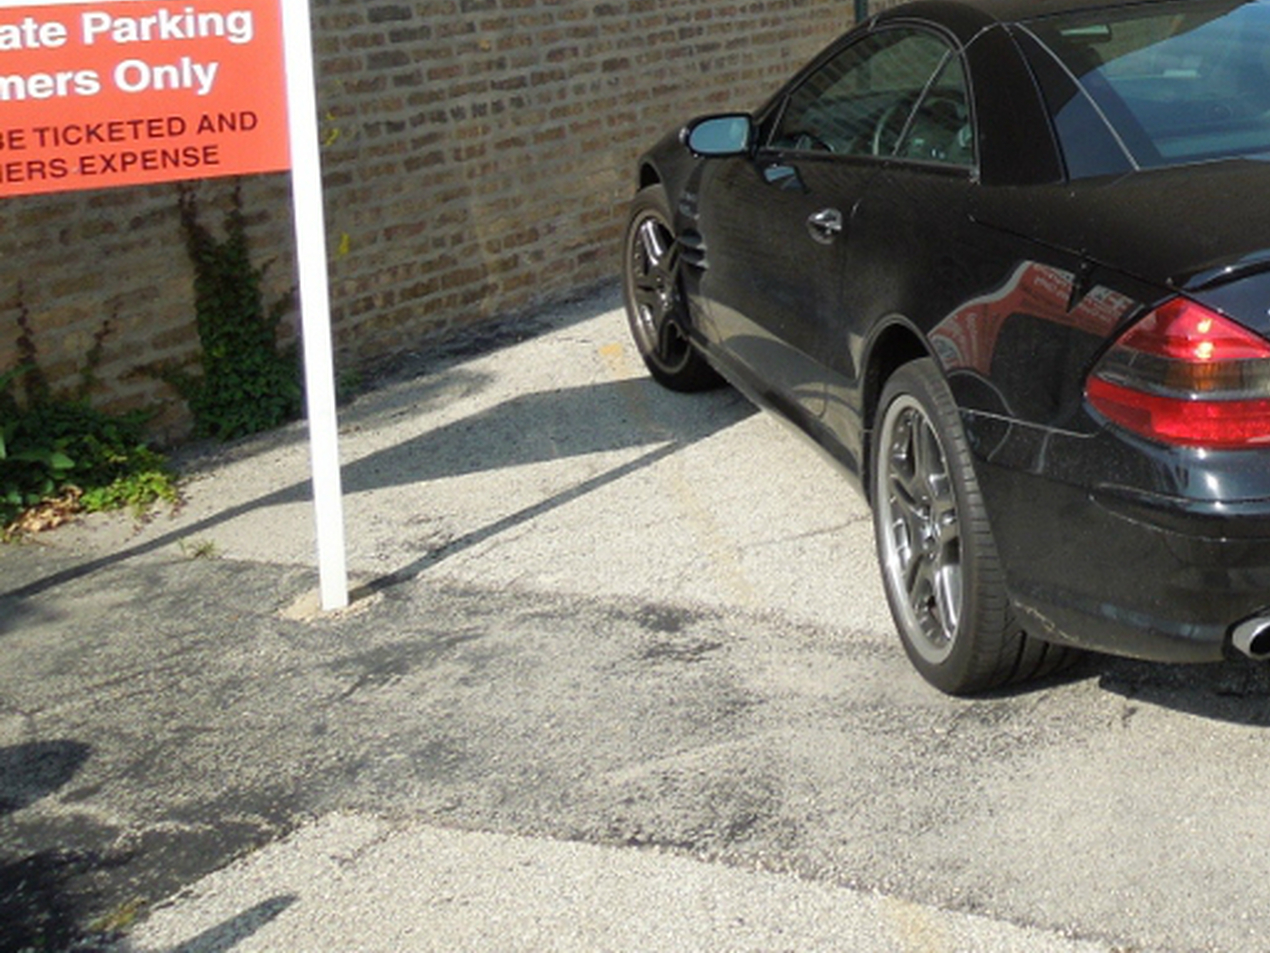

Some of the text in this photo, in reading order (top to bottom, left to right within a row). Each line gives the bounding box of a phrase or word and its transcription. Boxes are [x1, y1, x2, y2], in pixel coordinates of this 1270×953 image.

[82, 7, 253, 44] Parking
[114, 57, 218, 96] Only
[0, 110, 258, 150] E TICKETED AND
[0, 145, 220, 184] ERS EXPENSE
